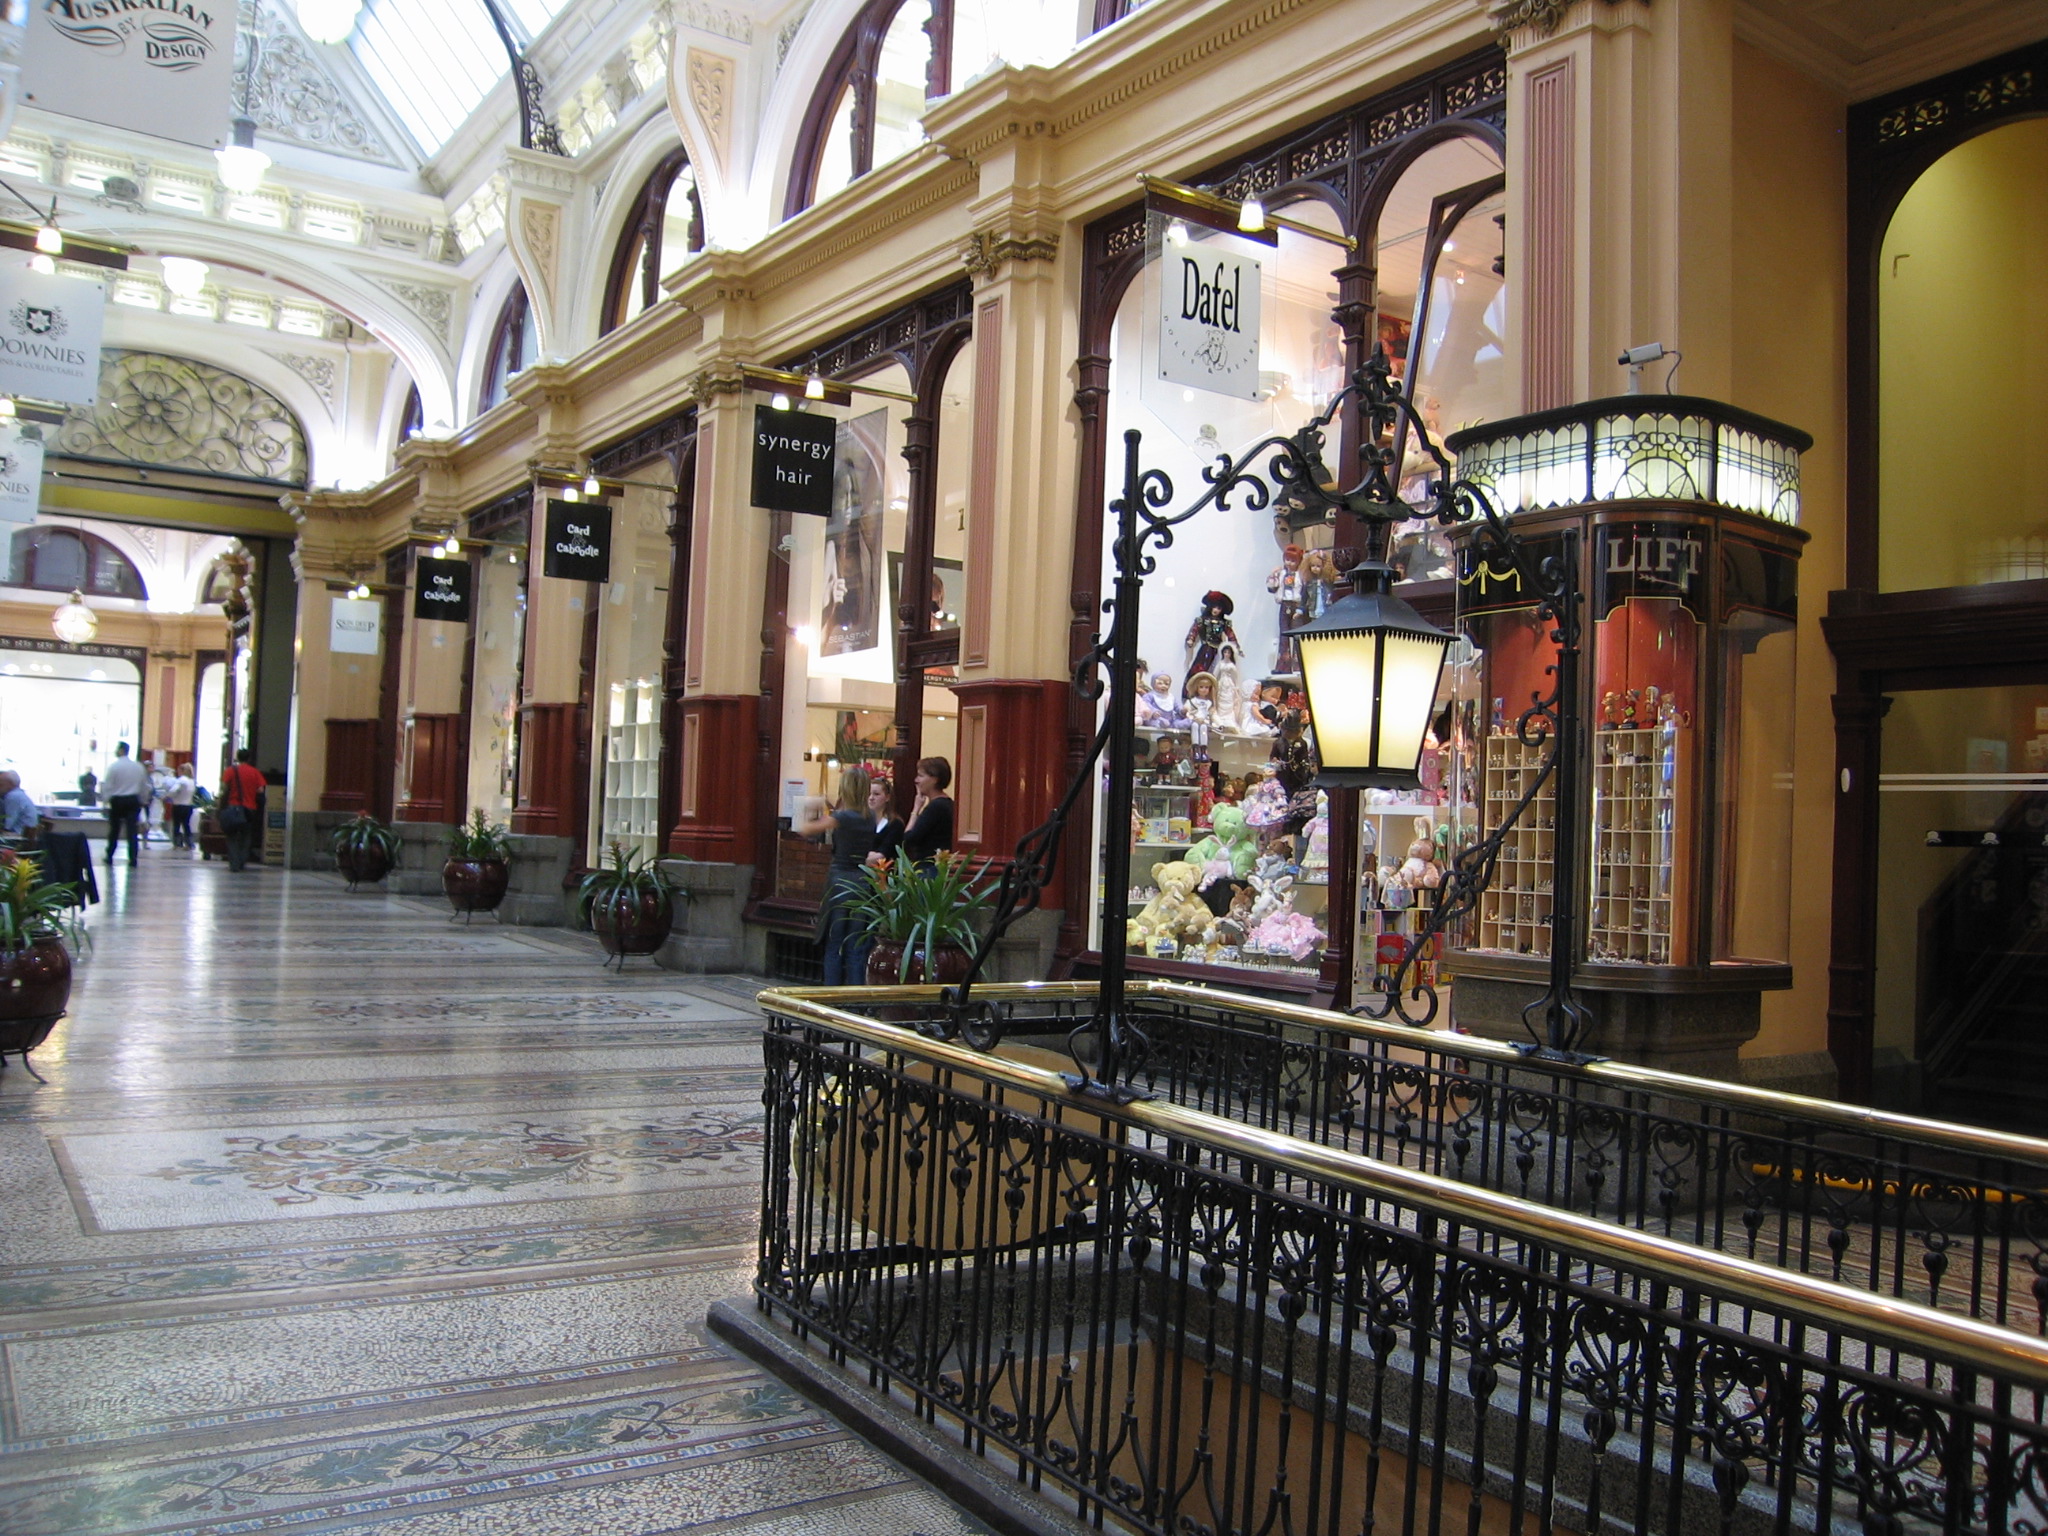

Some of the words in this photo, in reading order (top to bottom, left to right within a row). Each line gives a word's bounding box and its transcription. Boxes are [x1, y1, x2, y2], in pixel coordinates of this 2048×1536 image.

[43, 0, 213, 30] AUSTRALIAN
[118, 17, 137, 35] BY
[144, 40, 206, 60] DESIGN
[1181, 257, 1240, 333] Dafel
[758, 433, 831, 460] synergy
[776, 464, 812, 485] hair
[566, 523, 590, 536] Card
[556, 542, 600, 557] Caboodle
[1606, 537, 1702, 574] LIFT
[433, 575, 453, 586] Card
[424, 591, 461, 603] Caboodle
